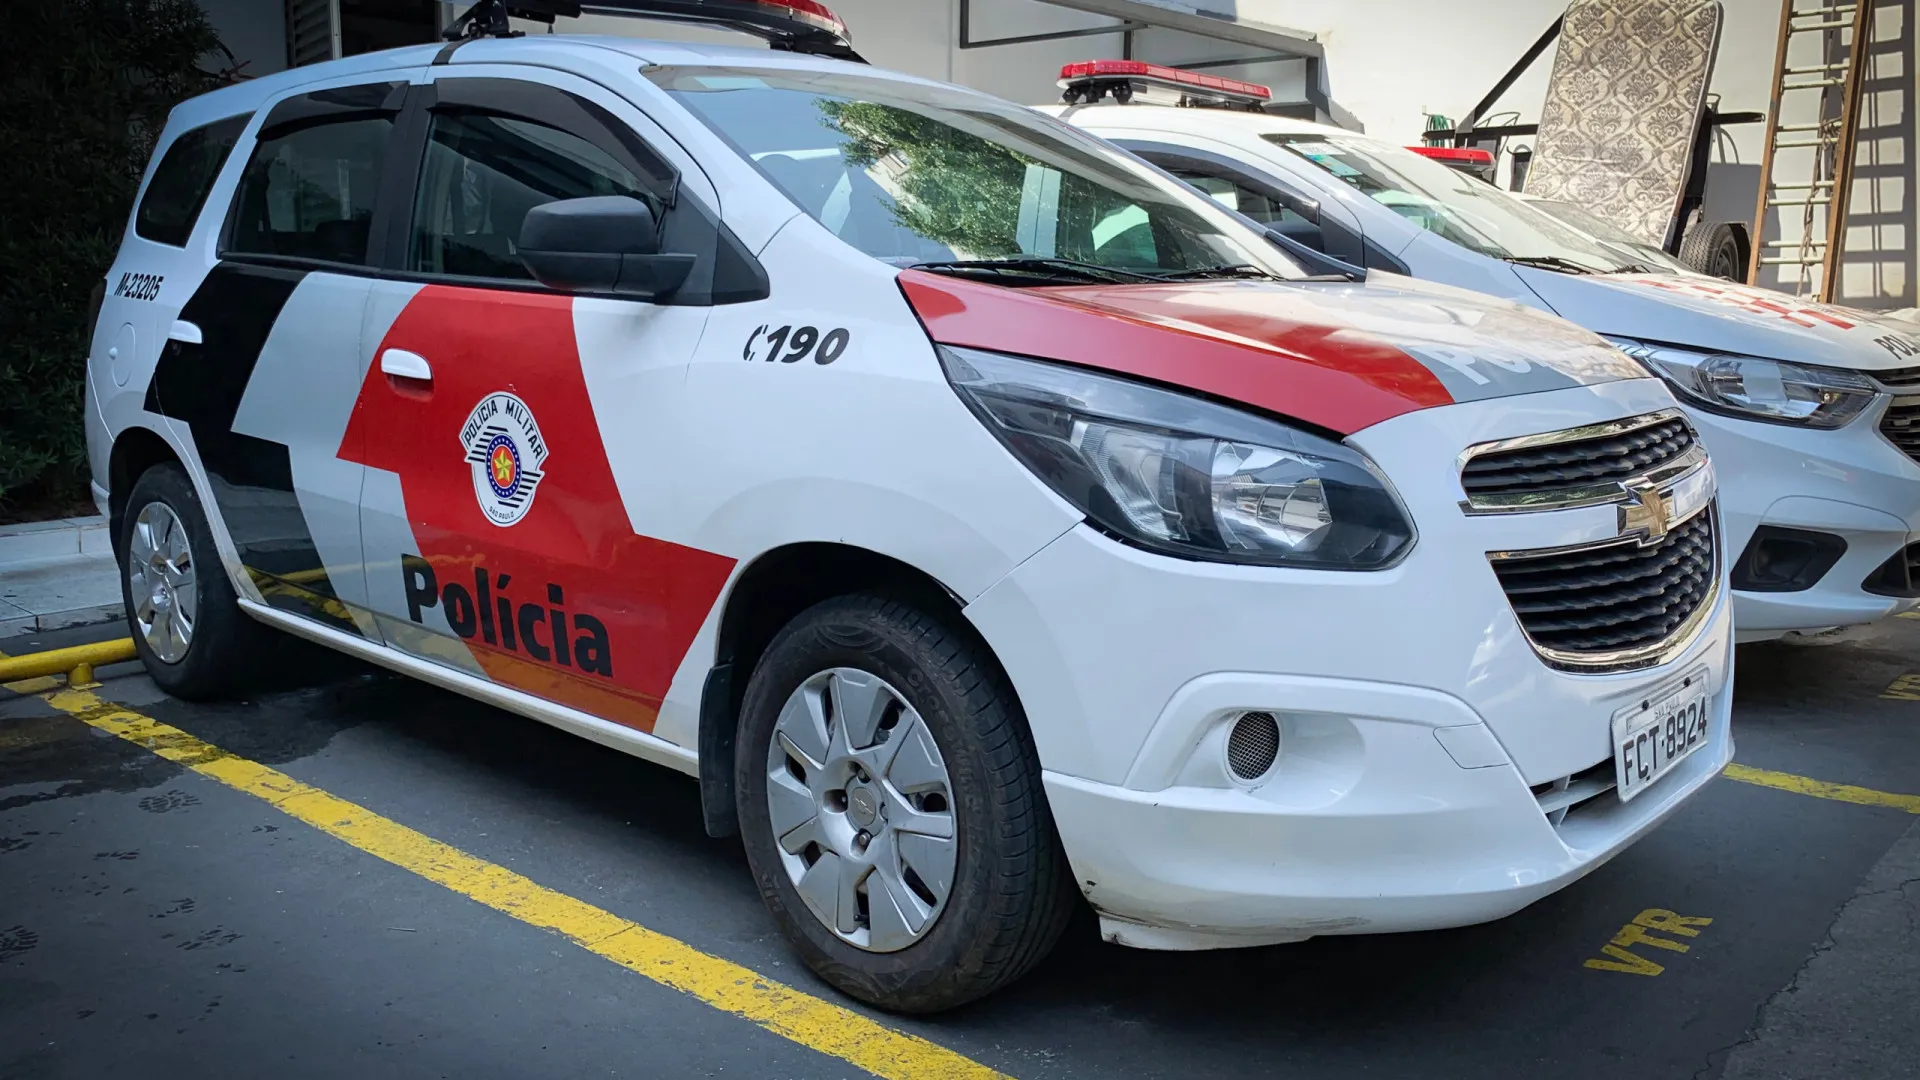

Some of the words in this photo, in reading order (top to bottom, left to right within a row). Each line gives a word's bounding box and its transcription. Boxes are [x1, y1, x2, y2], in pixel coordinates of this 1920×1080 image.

[114, 272, 164, 301] M-23205
[765, 325, 850, 366] 190
[505, 399, 544, 459] MILITAR
[401, 553, 613, 678] Polícia
[1583, 908, 1713, 976] VTR
